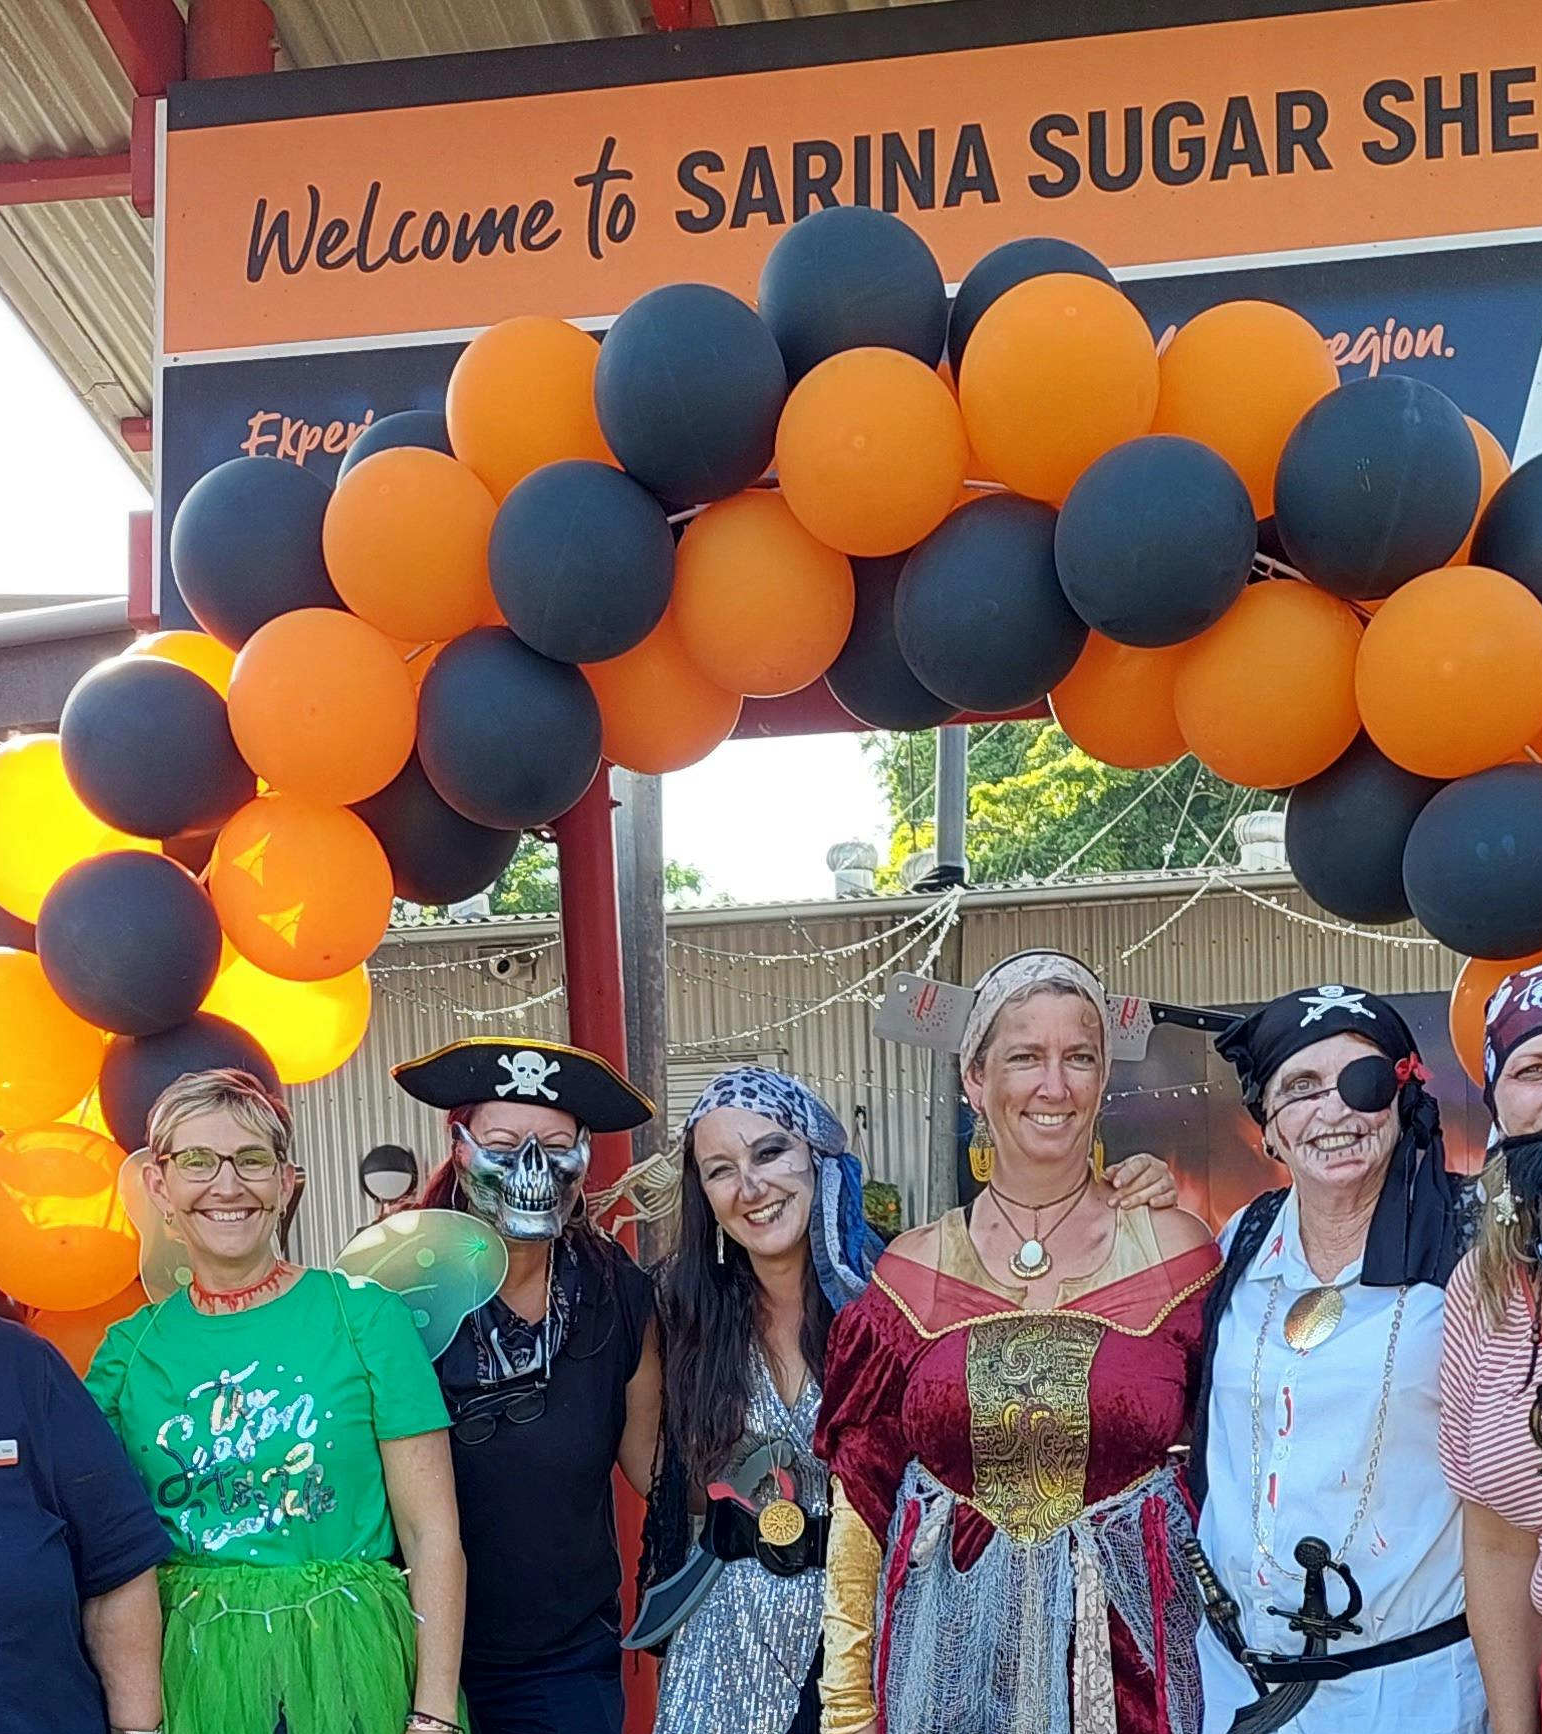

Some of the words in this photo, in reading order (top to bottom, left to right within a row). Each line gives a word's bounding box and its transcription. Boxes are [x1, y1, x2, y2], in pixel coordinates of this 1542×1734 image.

[246, 181, 561, 283] Welcome
[574, 136, 637, 260] to
[675, 123, 1000, 234] SARINA
[1028, 88, 1332, 200] SUGAR
[1323, 317, 1456, 378] egion.
